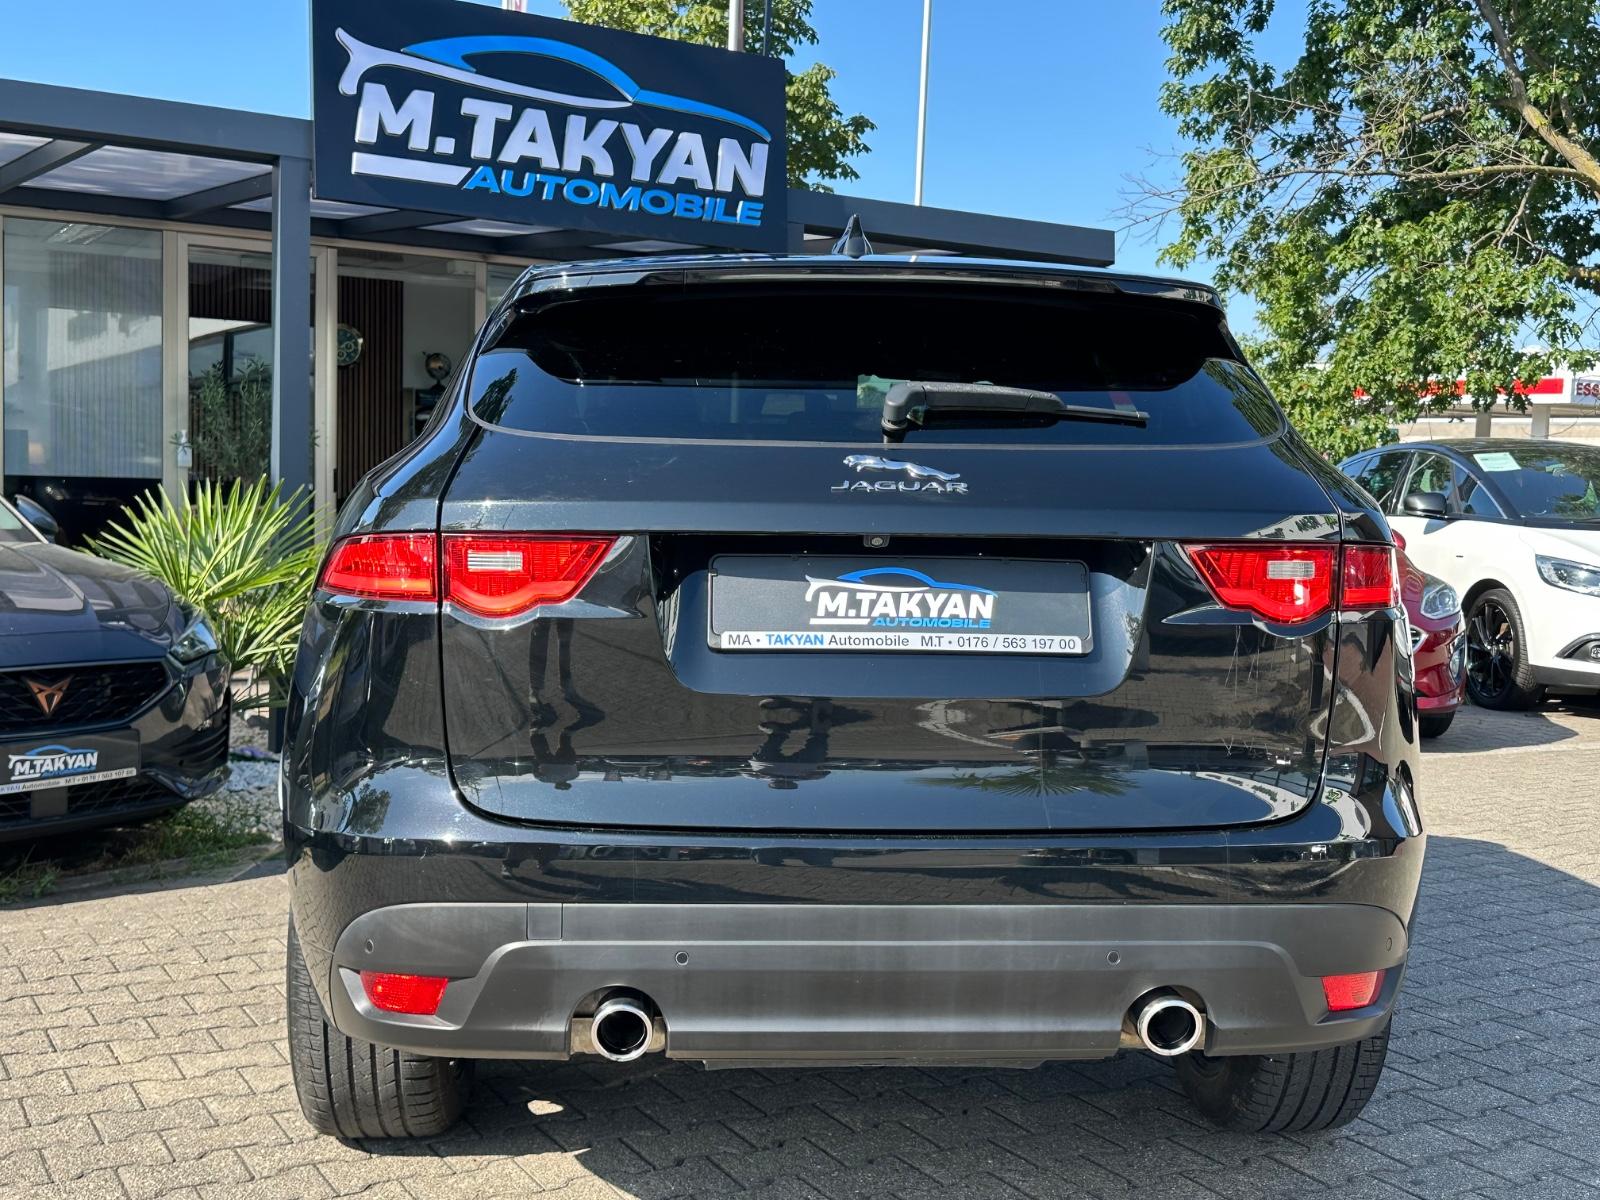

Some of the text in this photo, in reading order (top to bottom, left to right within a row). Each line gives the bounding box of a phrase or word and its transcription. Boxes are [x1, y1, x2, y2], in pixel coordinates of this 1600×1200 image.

[354, 82, 769, 197] M.TAKYAN
[462, 165, 764, 226] AUTOMOBILE
[830, 480, 969, 494] JAGUAR
[816, 591, 995, 618] M.TAKYAN
[872, 618, 991, 628] AUTOMOBILE
[728, 634, 751, 645] MA
[766, 634, 824, 645] TAKYAN
[828, 635, 909, 647] Automobile
[957, 637, 989, 648] 0176
[993, 637, 998, 648] /
[1002, 638, 1027, 648] 563
[1032, 639, 1054, 649] 197
[1059, 639, 1076, 650] 00
[14, 752, 98, 775] M.TAKYAN
